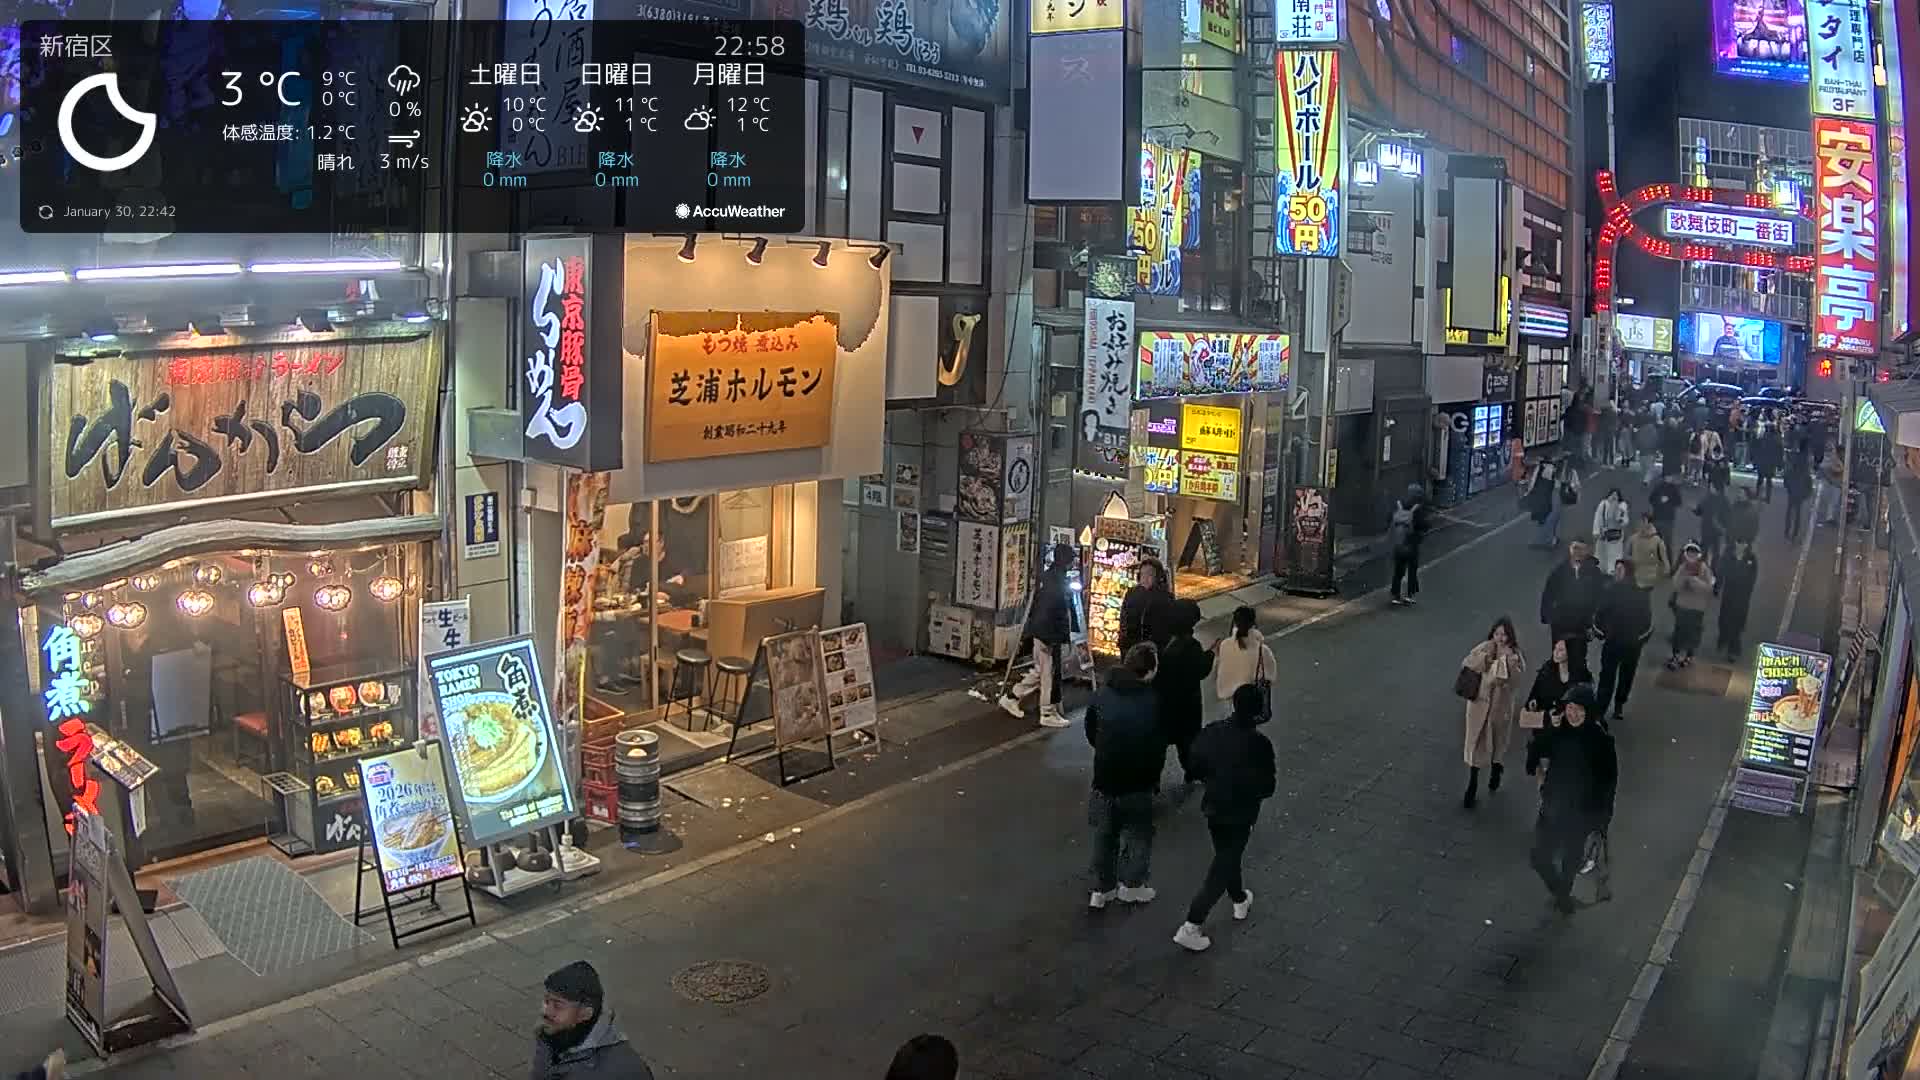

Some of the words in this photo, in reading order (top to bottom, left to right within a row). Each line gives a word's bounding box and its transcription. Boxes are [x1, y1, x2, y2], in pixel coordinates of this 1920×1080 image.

[1818, 0, 1843, 70] タイ
[1585, 64, 1610, 80] 7F
[1296, 55, 1321, 190] ハイボール
[1832, 98, 1856, 112] 3F
[1670, 212, 1789, 242] 歌舞伎町一番街
[1818, 126, 1875, 332] 安楽亭
[560, 255, 586, 401] 東京豚骨
[1101, 309, 1129, 416] お好み焼き
[668, 366, 823, 406] 芝浦ホルモン
[434, 664, 480, 684] TOKYO
[439, 677, 481, 697] RAMEN
[497, 653, 540, 721] 角煮
[1761, 667, 1807, 678] CHEESE
